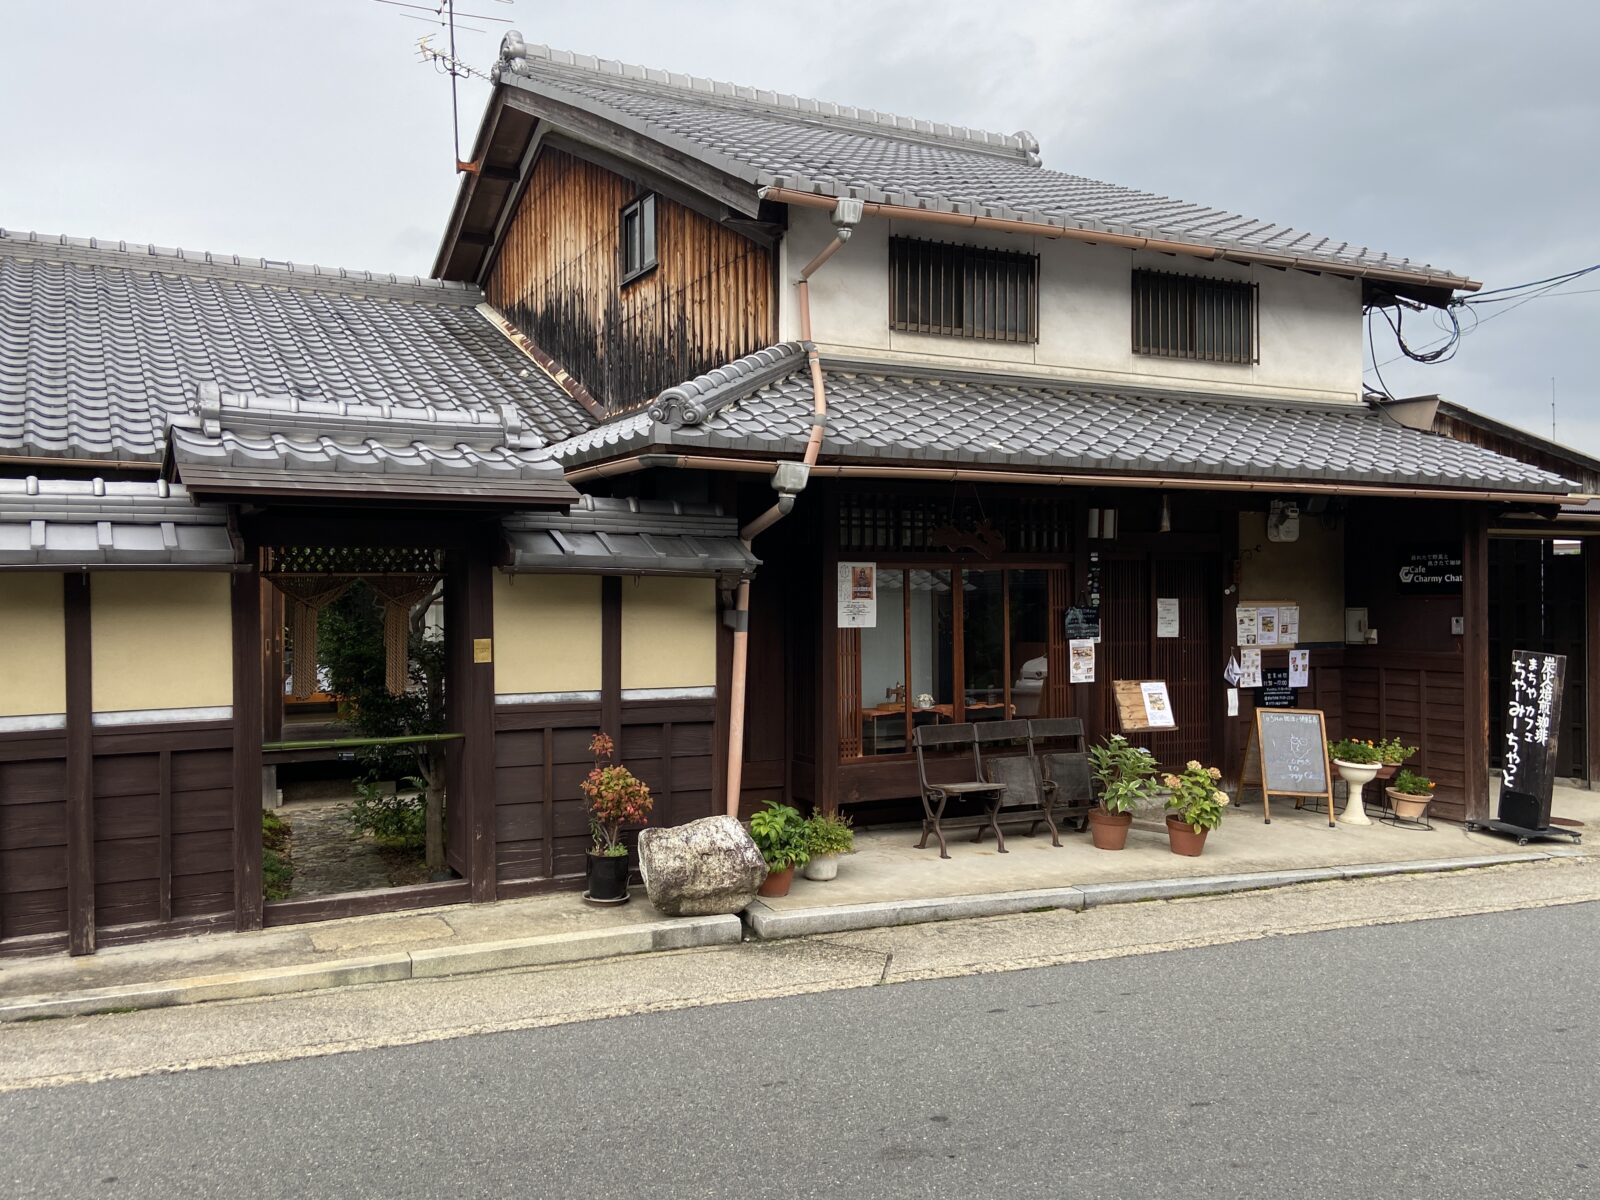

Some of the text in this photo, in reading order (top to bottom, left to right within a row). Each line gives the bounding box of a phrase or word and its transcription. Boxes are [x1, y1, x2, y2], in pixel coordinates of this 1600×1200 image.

[1414, 574, 1463, 583] Charmy Chat
[1526, 658, 1538, 699] まちや
[1534, 656, 1556, 747] 炭火焙煎珈琲
